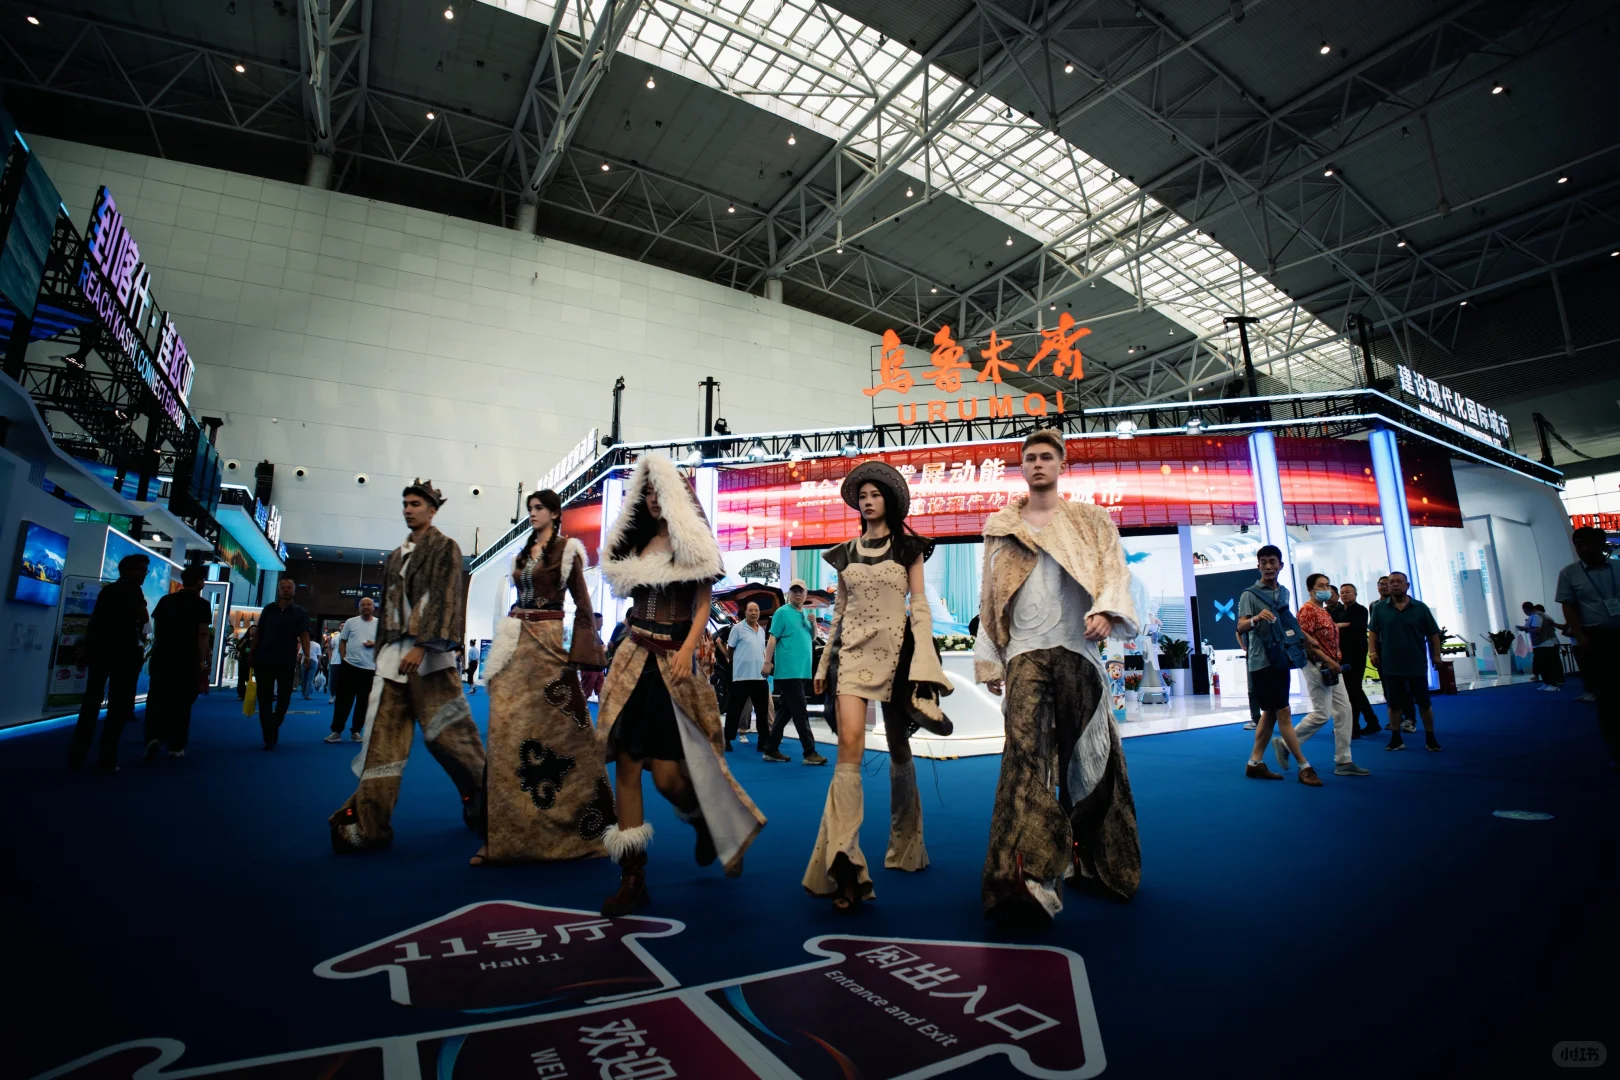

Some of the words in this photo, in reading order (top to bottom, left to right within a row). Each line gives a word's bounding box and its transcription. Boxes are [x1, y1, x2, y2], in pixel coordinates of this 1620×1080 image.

[78, 260, 115, 328] REACH
[137, 349, 168, 405] CONNECT
[897, 390, 1066, 426] URUMQI
[1397, 364, 1511, 439] 建设现代化国际城市
[394, 918, 615, 964] 11号厅
[480, 955, 530, 971] Hall
[537, 951, 565, 963] 11
[824, 970, 888, 1008] Entrance
[884, 1004, 922, 1033] and
[917, 1024, 959, 1048] Exit
[890, 962, 1061, 1040] 出入口
